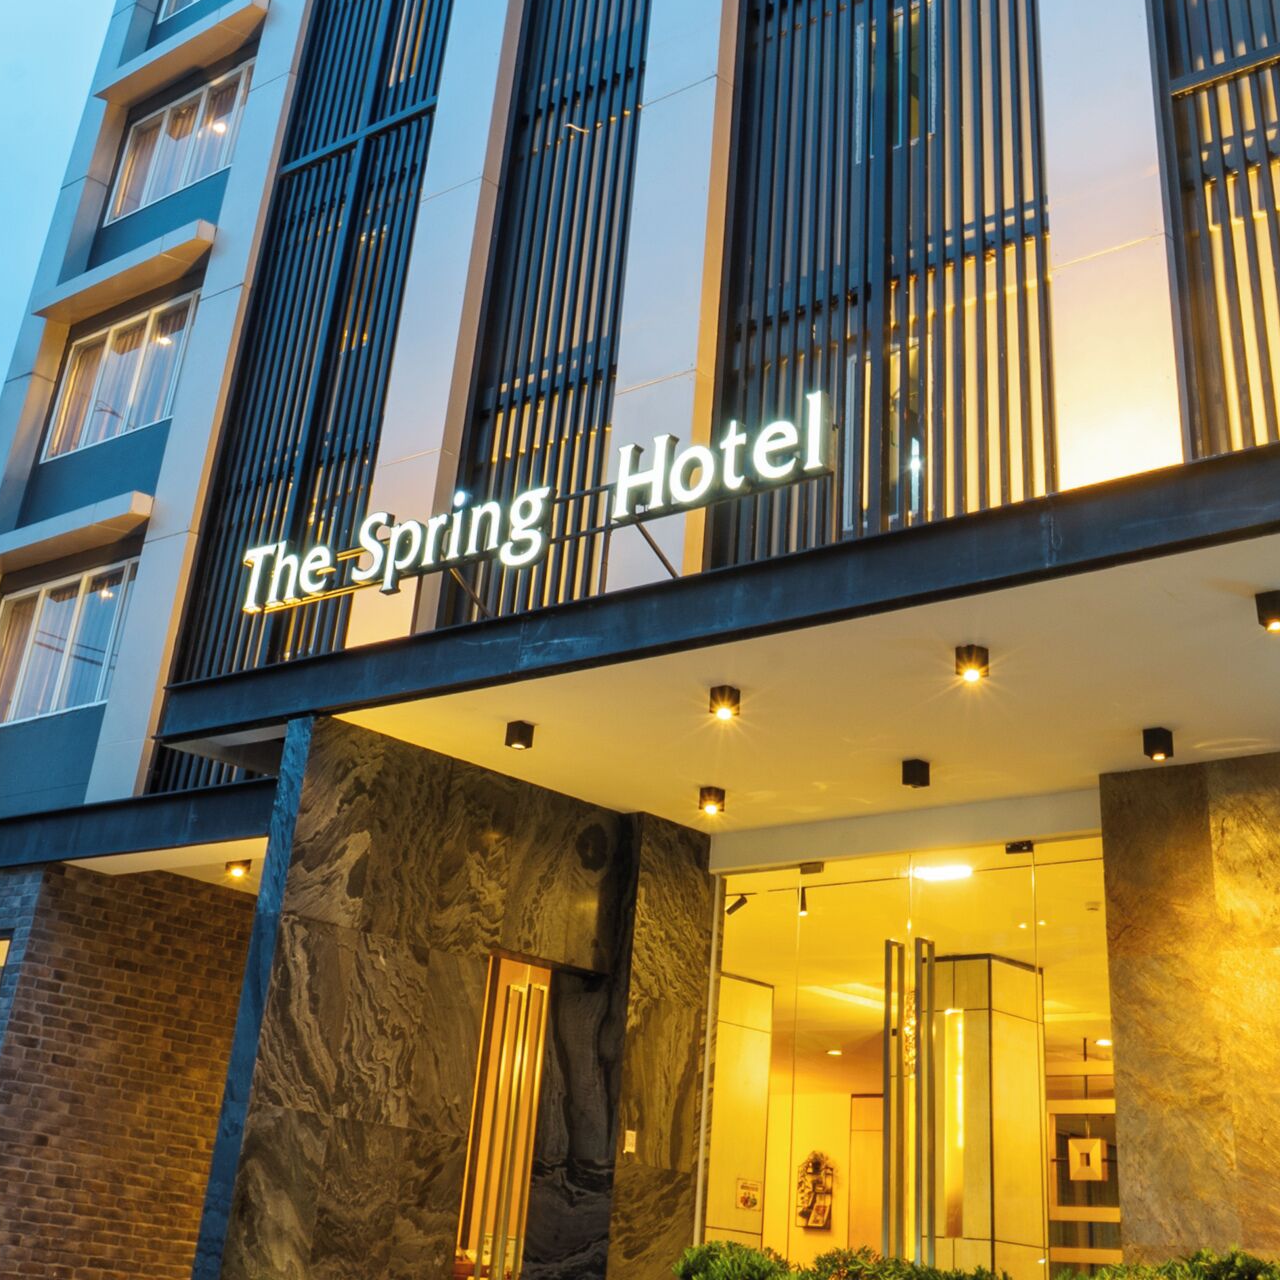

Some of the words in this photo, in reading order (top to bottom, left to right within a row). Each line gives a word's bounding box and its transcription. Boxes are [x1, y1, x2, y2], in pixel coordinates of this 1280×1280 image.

[242, 540, 337, 613] The
[350, 485, 557, 596] Spring
[612, 390, 833, 521] Hotel
